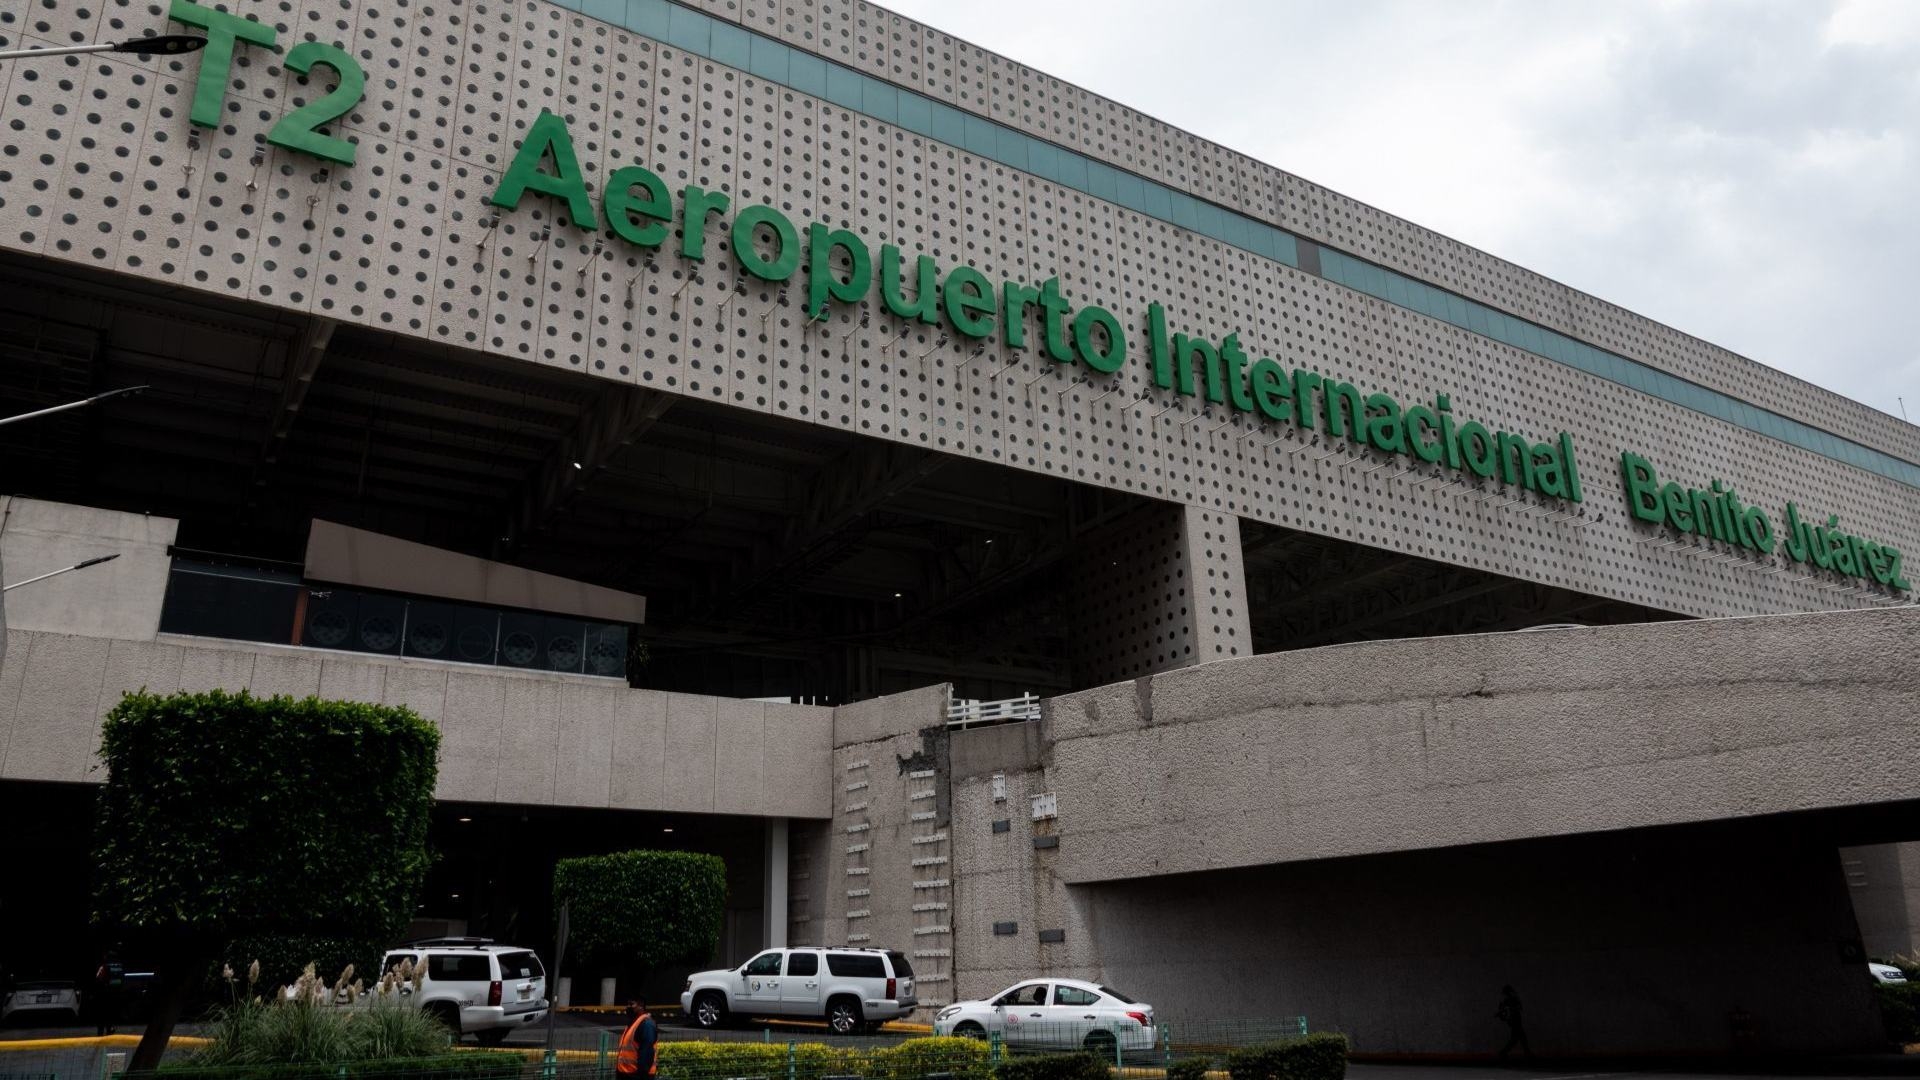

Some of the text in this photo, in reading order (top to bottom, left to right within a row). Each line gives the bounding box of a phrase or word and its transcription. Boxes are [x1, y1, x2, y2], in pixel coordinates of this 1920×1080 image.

[168, 0, 1911, 591] T2 Aeropuerto Internacional Benito Juárez
